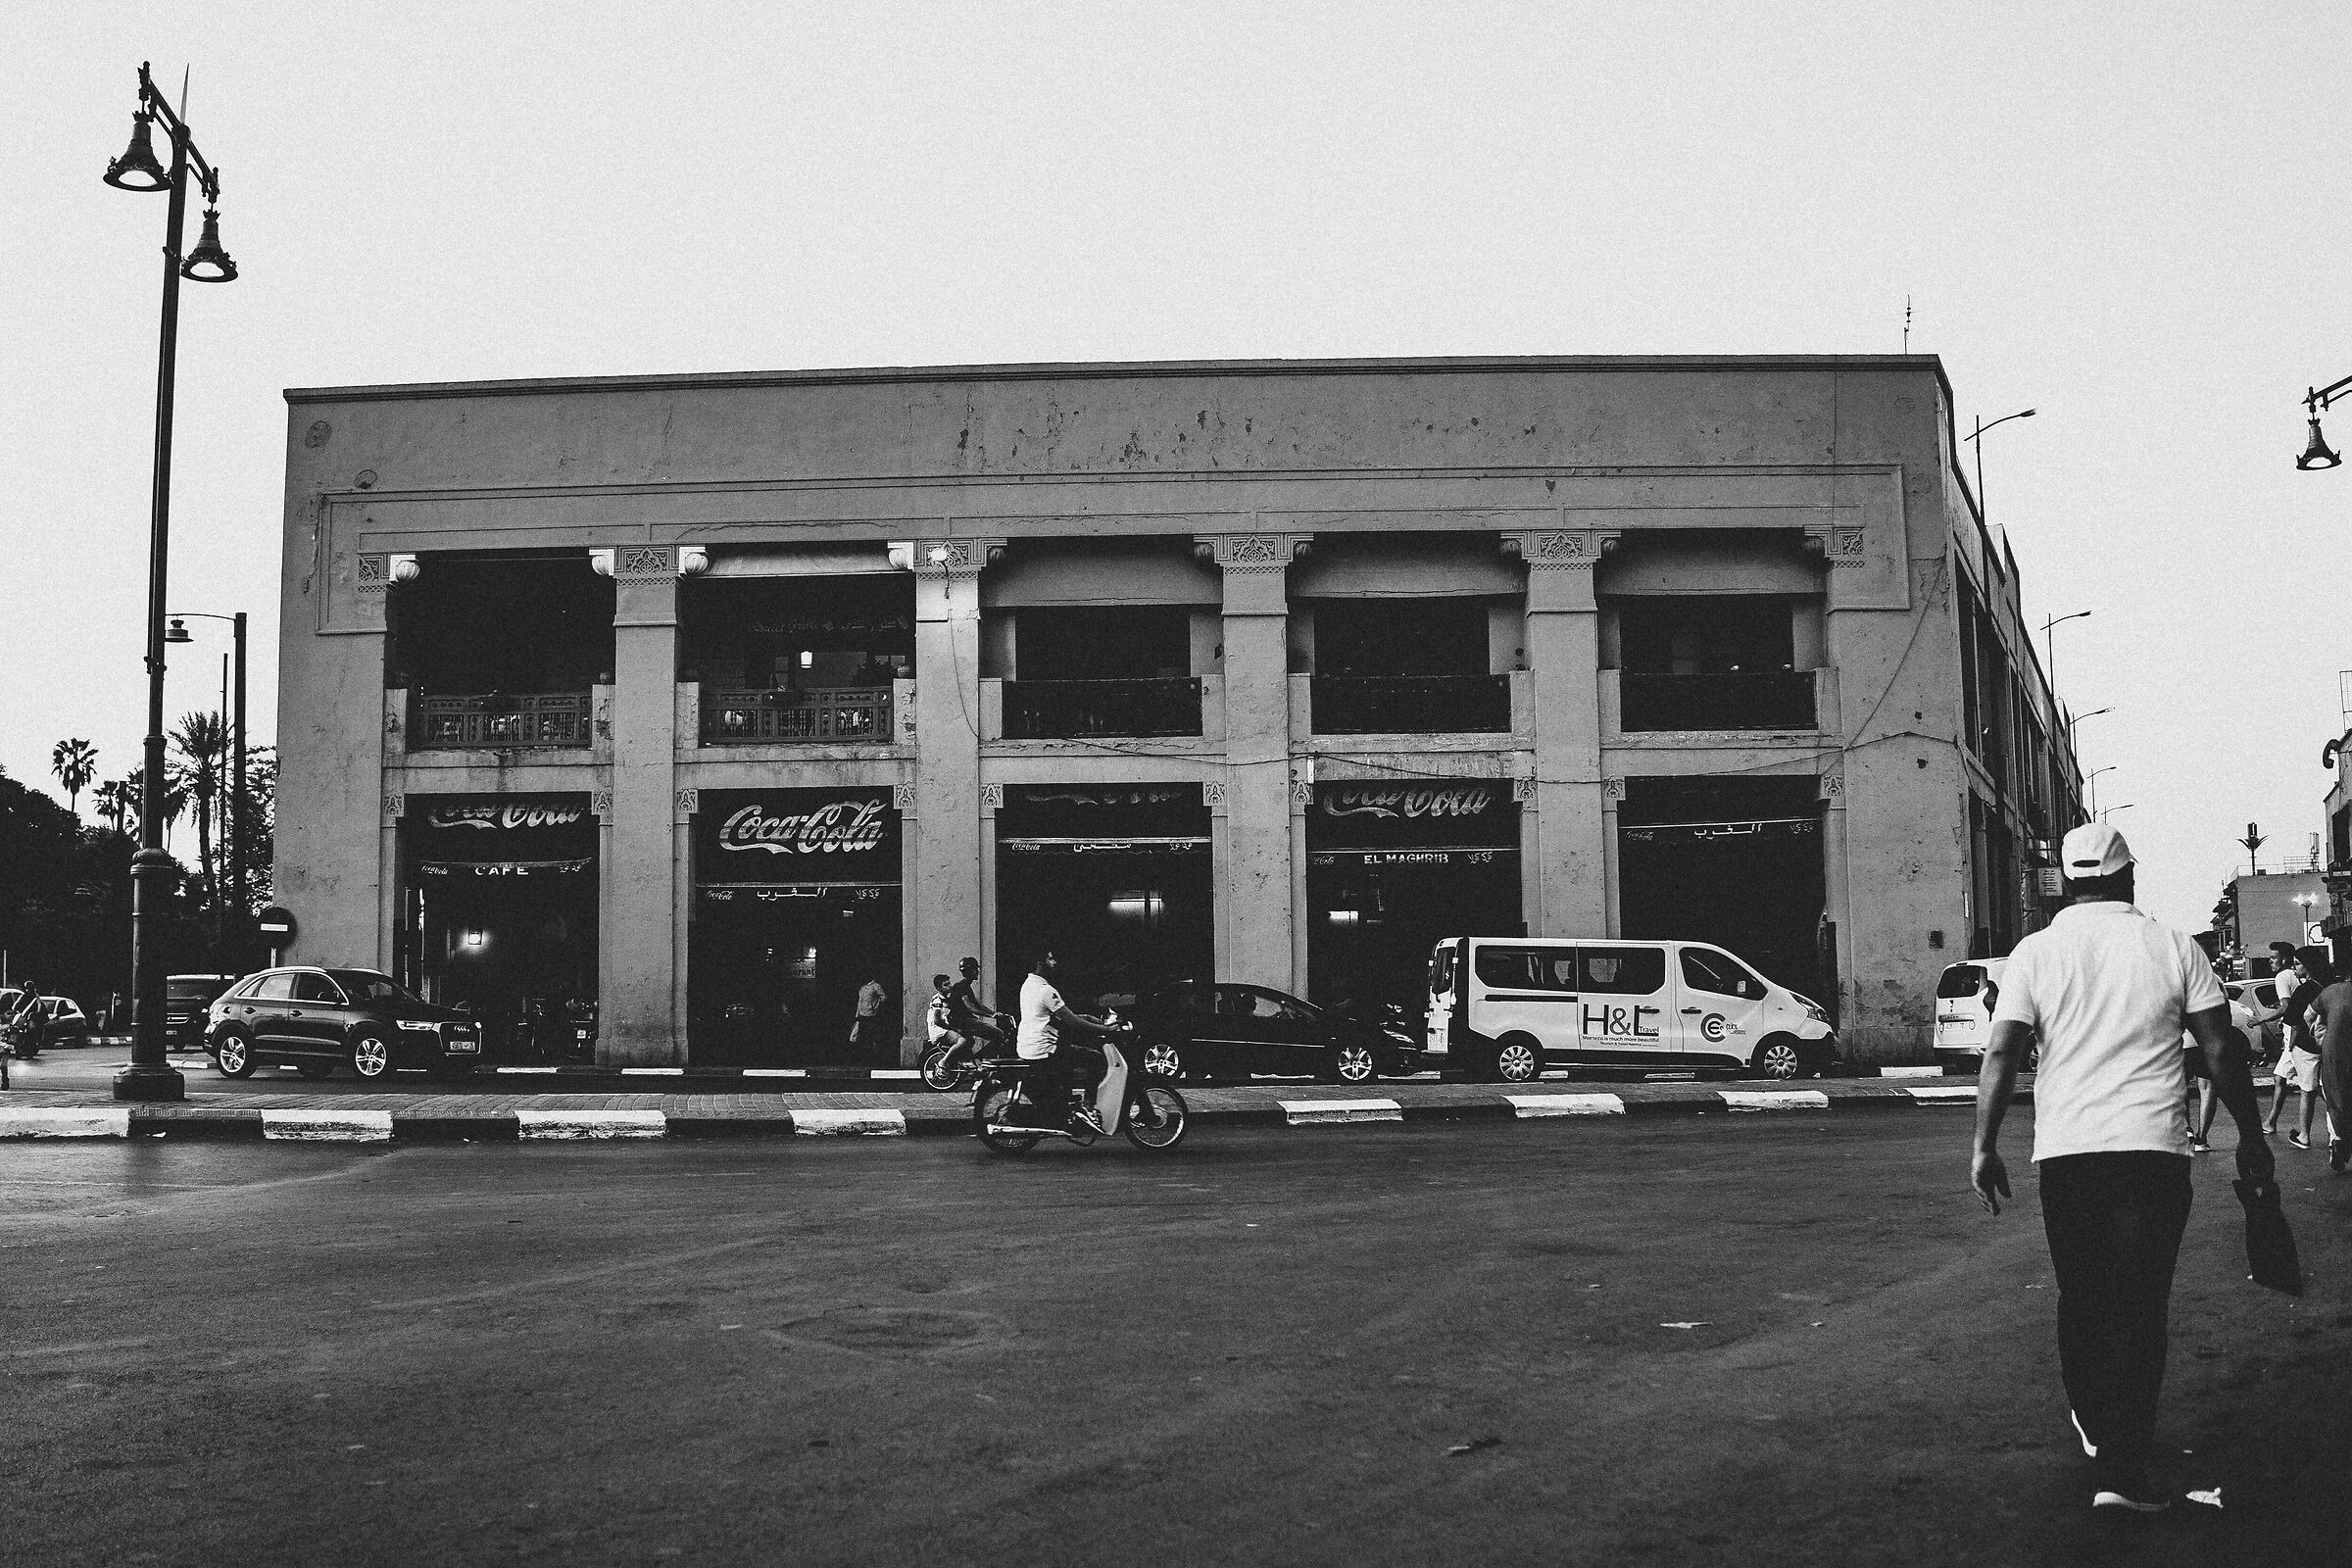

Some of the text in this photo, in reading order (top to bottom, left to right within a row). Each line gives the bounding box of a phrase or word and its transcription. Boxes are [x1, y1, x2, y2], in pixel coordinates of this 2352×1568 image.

[1323, 788, 1492, 818] CocaCola
[719, 799, 887, 855] Coca-Cola
[1364, 854, 1449, 864] EL MAGHRIB
